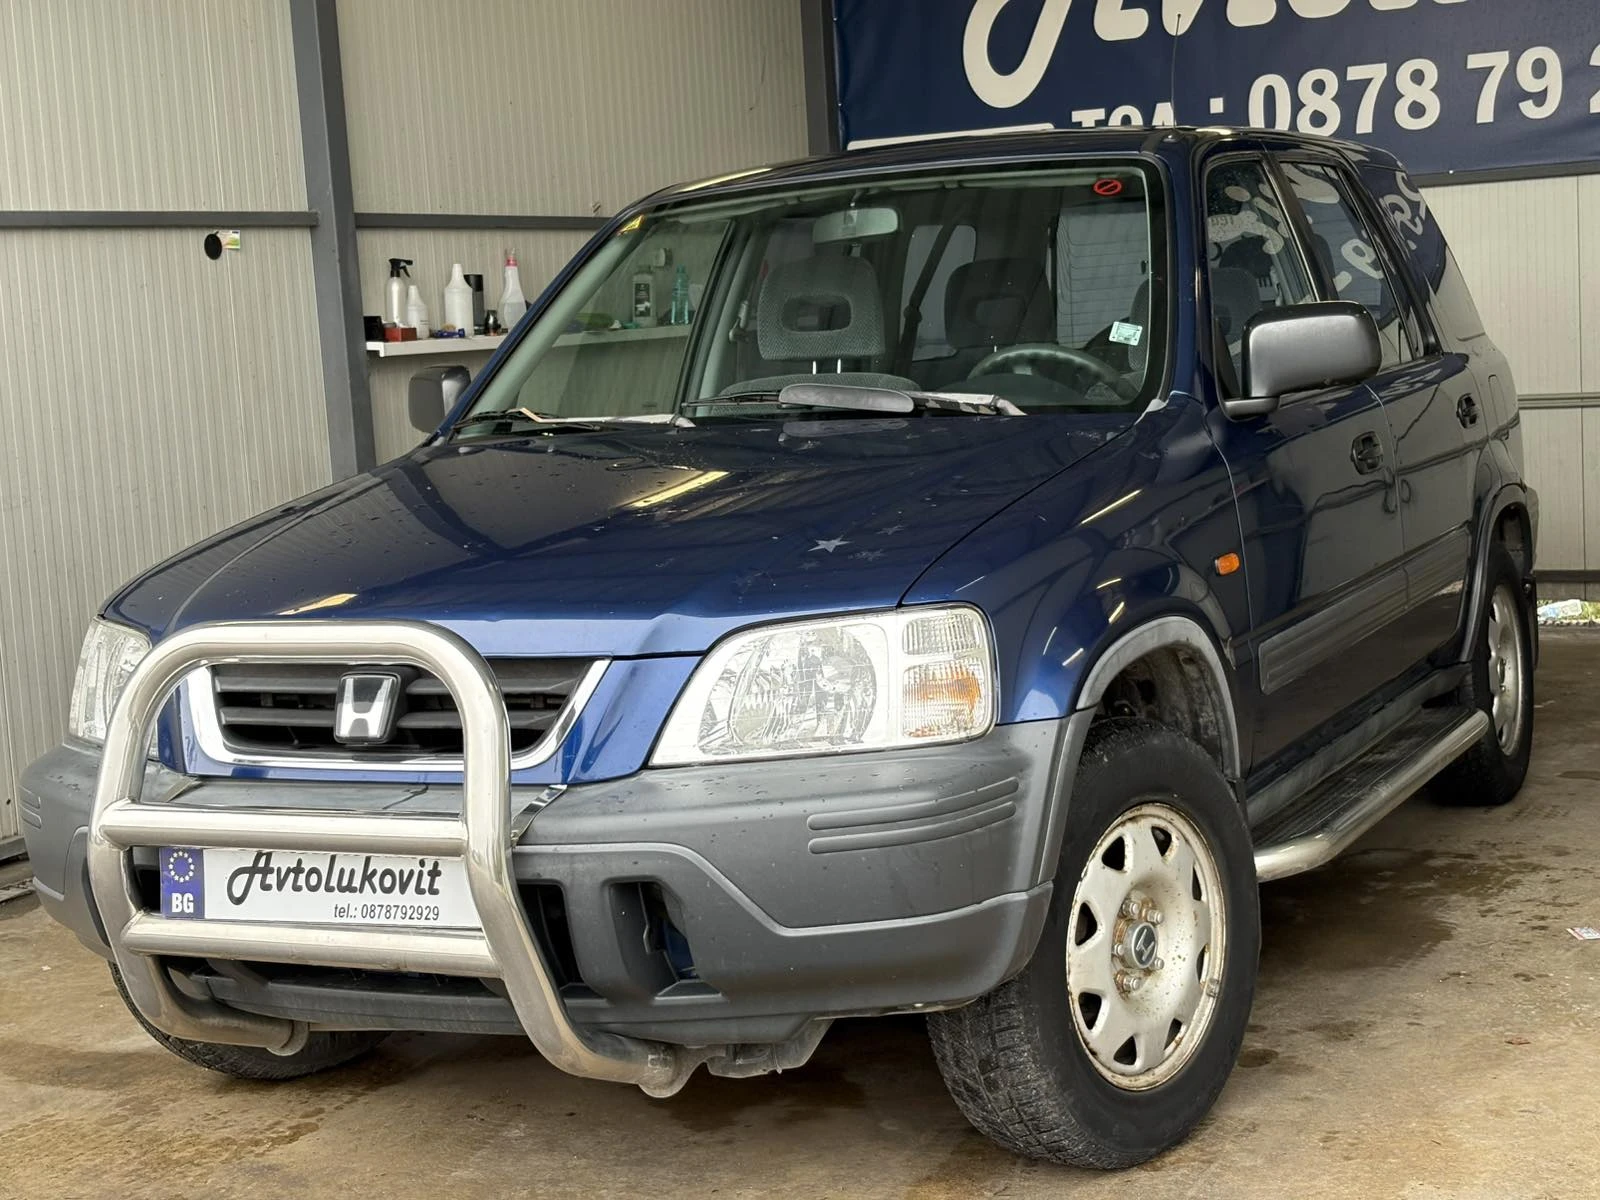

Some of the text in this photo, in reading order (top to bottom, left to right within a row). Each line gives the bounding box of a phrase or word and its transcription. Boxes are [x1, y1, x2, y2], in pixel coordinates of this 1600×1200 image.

[1248, 58, 1441, 136] 0878
[1466, 46, 1563, 124] 79
[226, 851, 442, 905] Avtolukovit
[171, 892, 194, 914] BG
[333, 903, 440, 921] tel.: 0878792929
